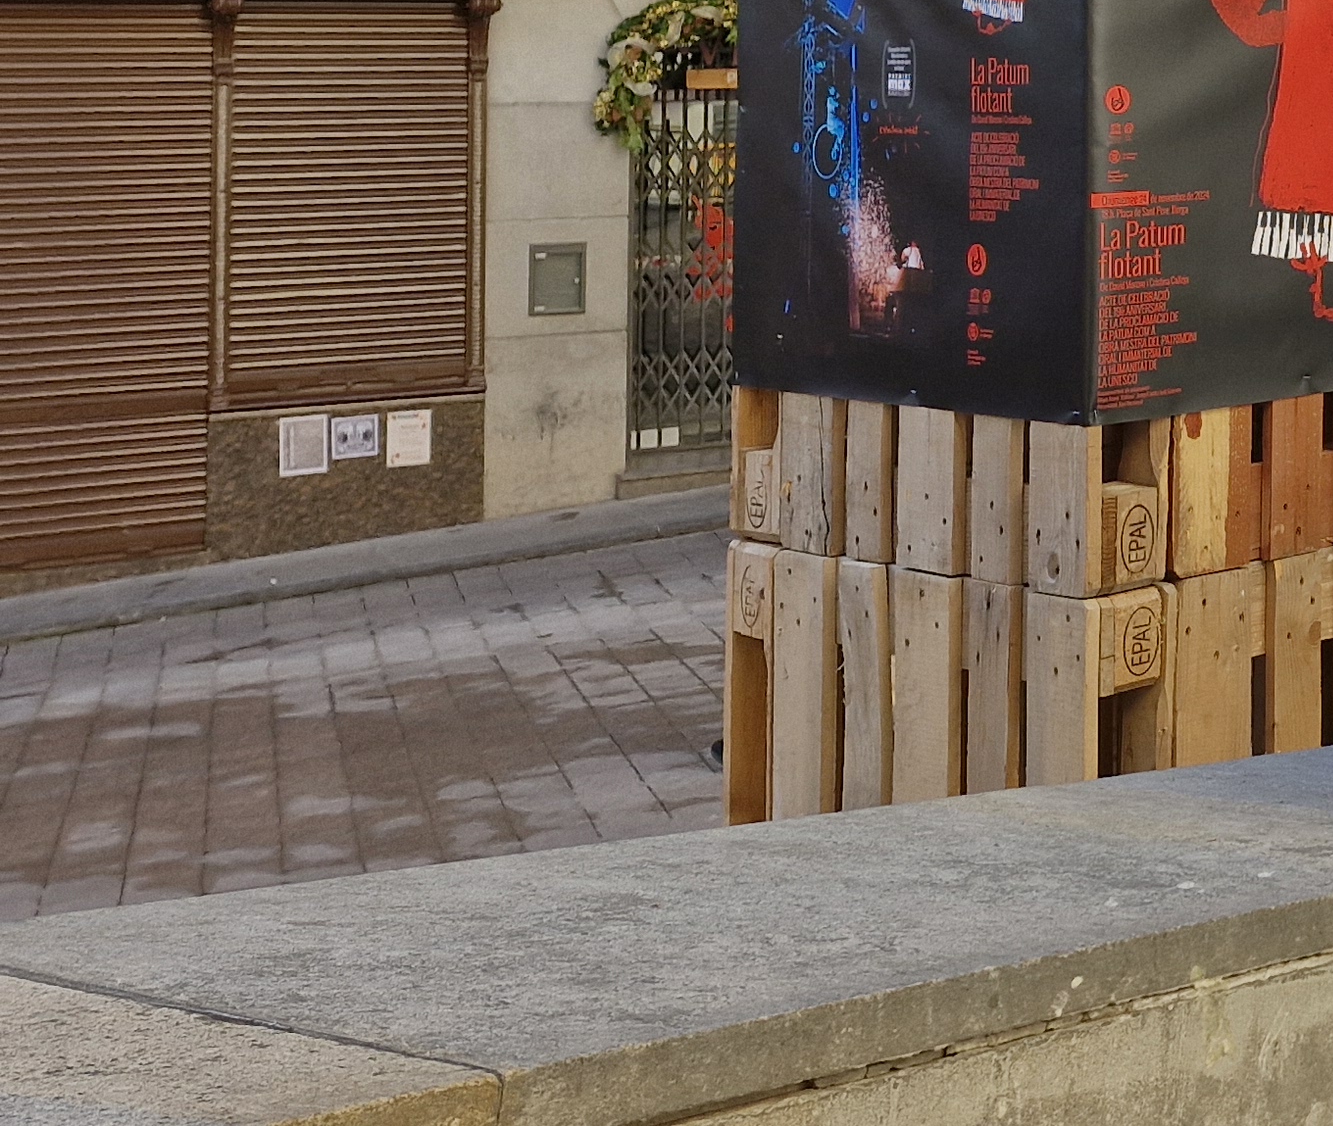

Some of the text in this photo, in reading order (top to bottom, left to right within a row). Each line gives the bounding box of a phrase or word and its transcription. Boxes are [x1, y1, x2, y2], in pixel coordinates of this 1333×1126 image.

[971, 57, 1030, 85] La Patum
[971, 86, 1013, 113] flotant
[1101, 220, 1185, 251] La Patum
[1098, 248, 1161, 280] flotant
[1108, 372, 1138, 387] UNESCO
[1128, 513, 1147, 564] EPAL
[1131, 614, 1152, 667] EPAL
